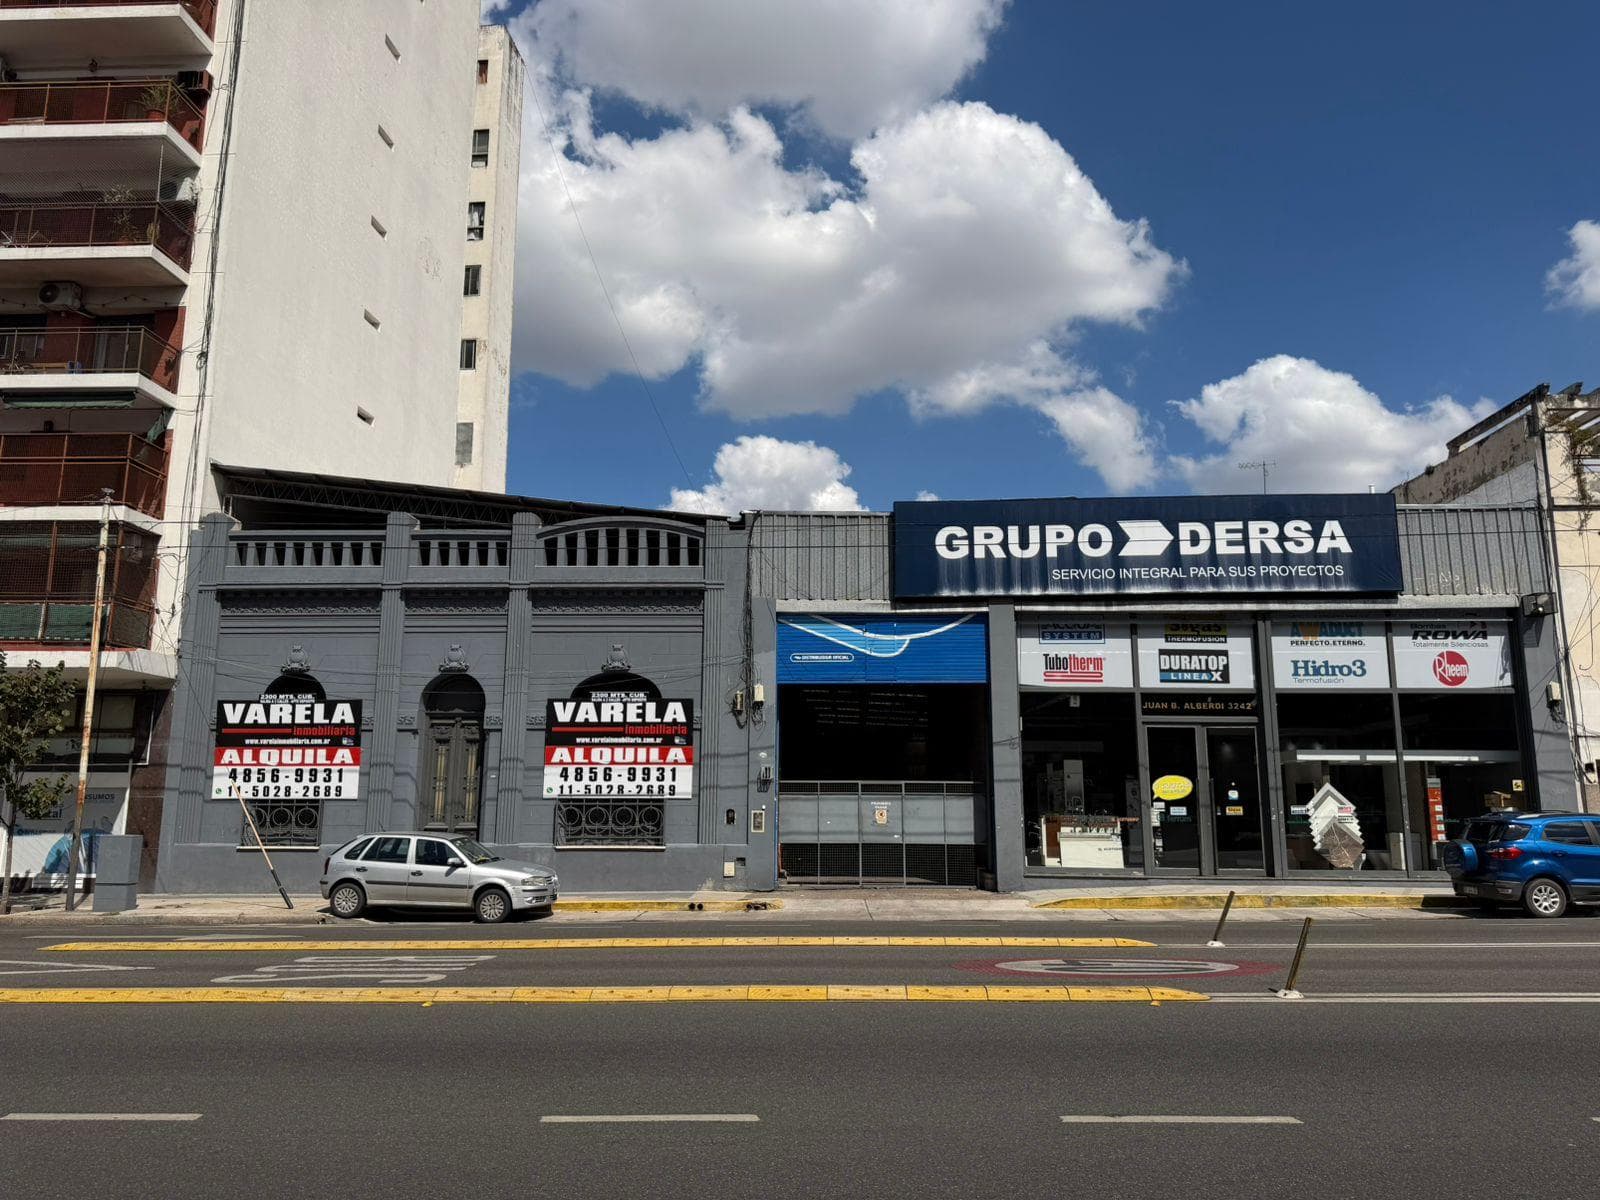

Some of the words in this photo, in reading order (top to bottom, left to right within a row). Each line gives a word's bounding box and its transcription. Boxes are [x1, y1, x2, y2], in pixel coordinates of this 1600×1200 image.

[934, 523, 1113, 560] GRUPO
[1178, 519, 1353, 556] DERSA
[1052, 568, 1115, 580] SERVICIO
[1119, 567, 1187, 579] INTEGRAL
[1190, 566, 1226, 578] PARA
[1228, 566, 1256, 577] SUS
[1260, 565, 1344, 577] PROYECTOS
[1044, 631, 1101, 641] SYSTEM
[1411, 630, 1488, 641] ROWA
[1043, 653, 1104, 671] Tubotherm
[1159, 655, 1228, 670] DURATOP
[1290, 659, 1367, 677] Hidro3
[1434, 650, 1468, 682] Rheem
[1170, 672, 1210, 680] LINEA
[1210, 671, 1223, 682] X
[223, 703, 355, 724] VARELA
[553, 702, 687, 723] VARELA
[1142, 702, 1169, 710] JUAN
[1184, 702, 1225, 710] ALBERDI
[1227, 702, 1253, 710] 3242
[293, 725, 356, 736] inmobiliaria
[625, 724, 688, 735] inmobiliaria
[220, 749, 354, 766] ALQUILA
[550, 747, 687, 765] ALQUILA
[228, 768, 344, 783] 4856-9931
[559, 767, 677, 782] 4856-9931
[558, 784, 676, 796] 11-5028-2689
